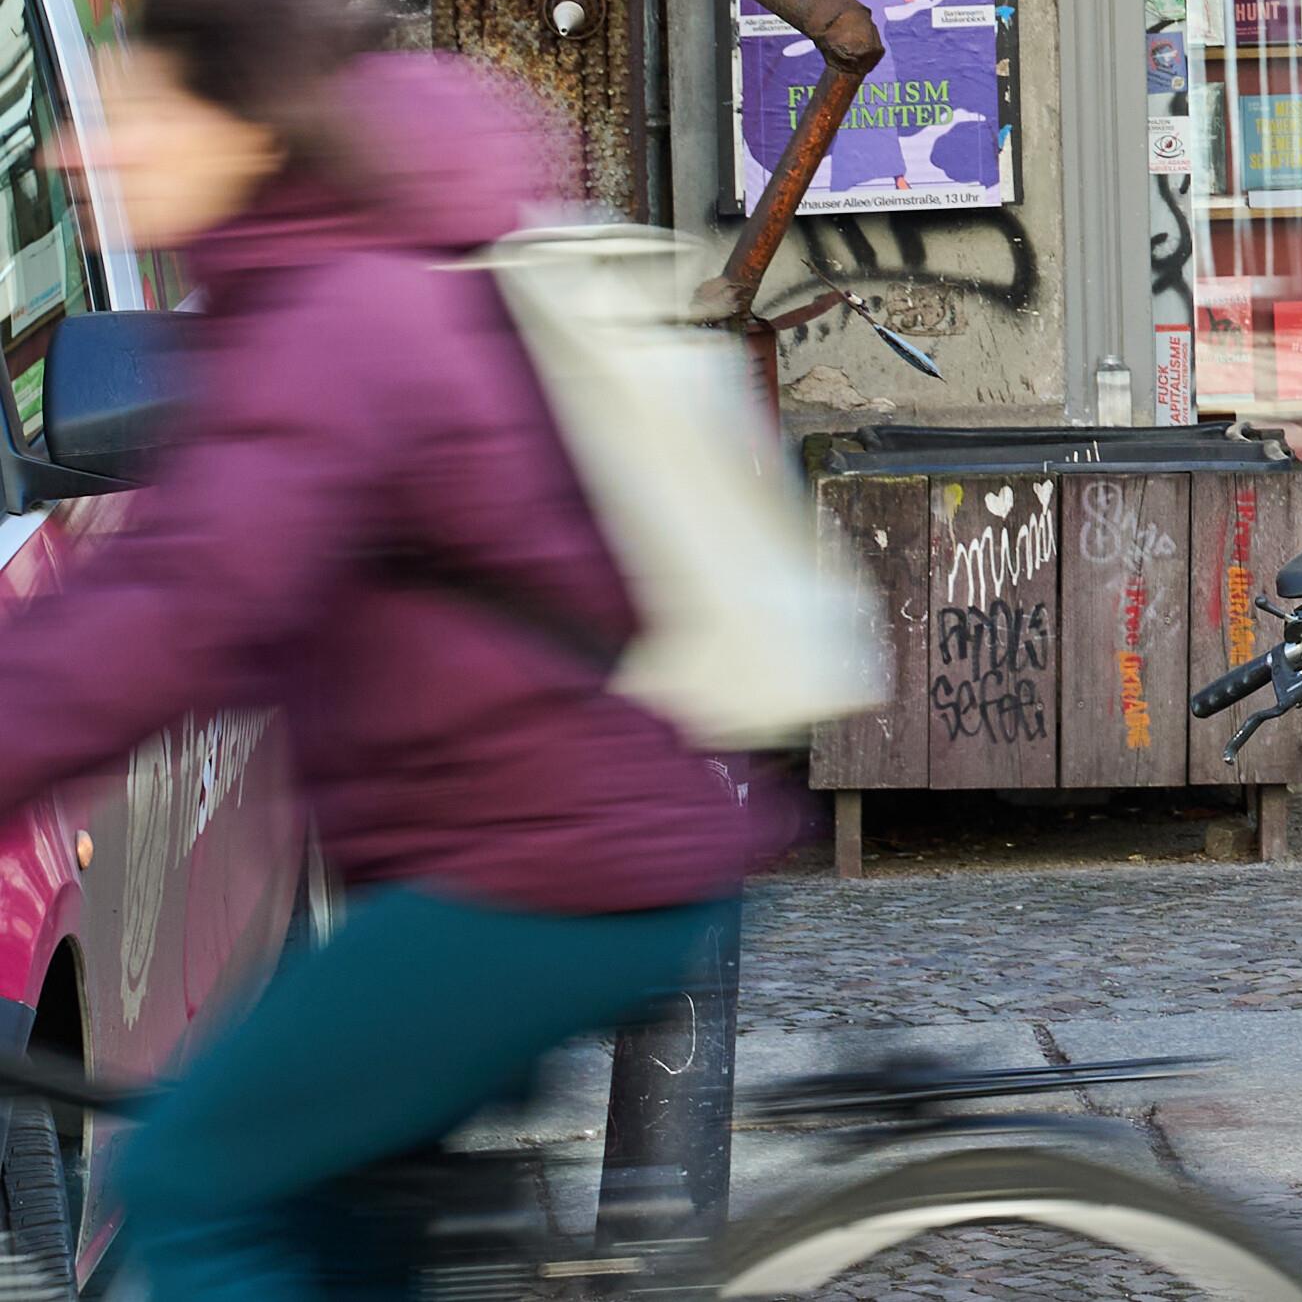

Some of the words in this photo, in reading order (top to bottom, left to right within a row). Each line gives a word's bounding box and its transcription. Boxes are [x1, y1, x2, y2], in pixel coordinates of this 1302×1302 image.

[1236, 1, 1281, 21] HUNT
[946, 195, 956, 204] 13
[957, 193, 980, 204] Uhr
[1158, 365, 1168, 405] FUCK
[1170, 336, 1181, 425] APITALISME
